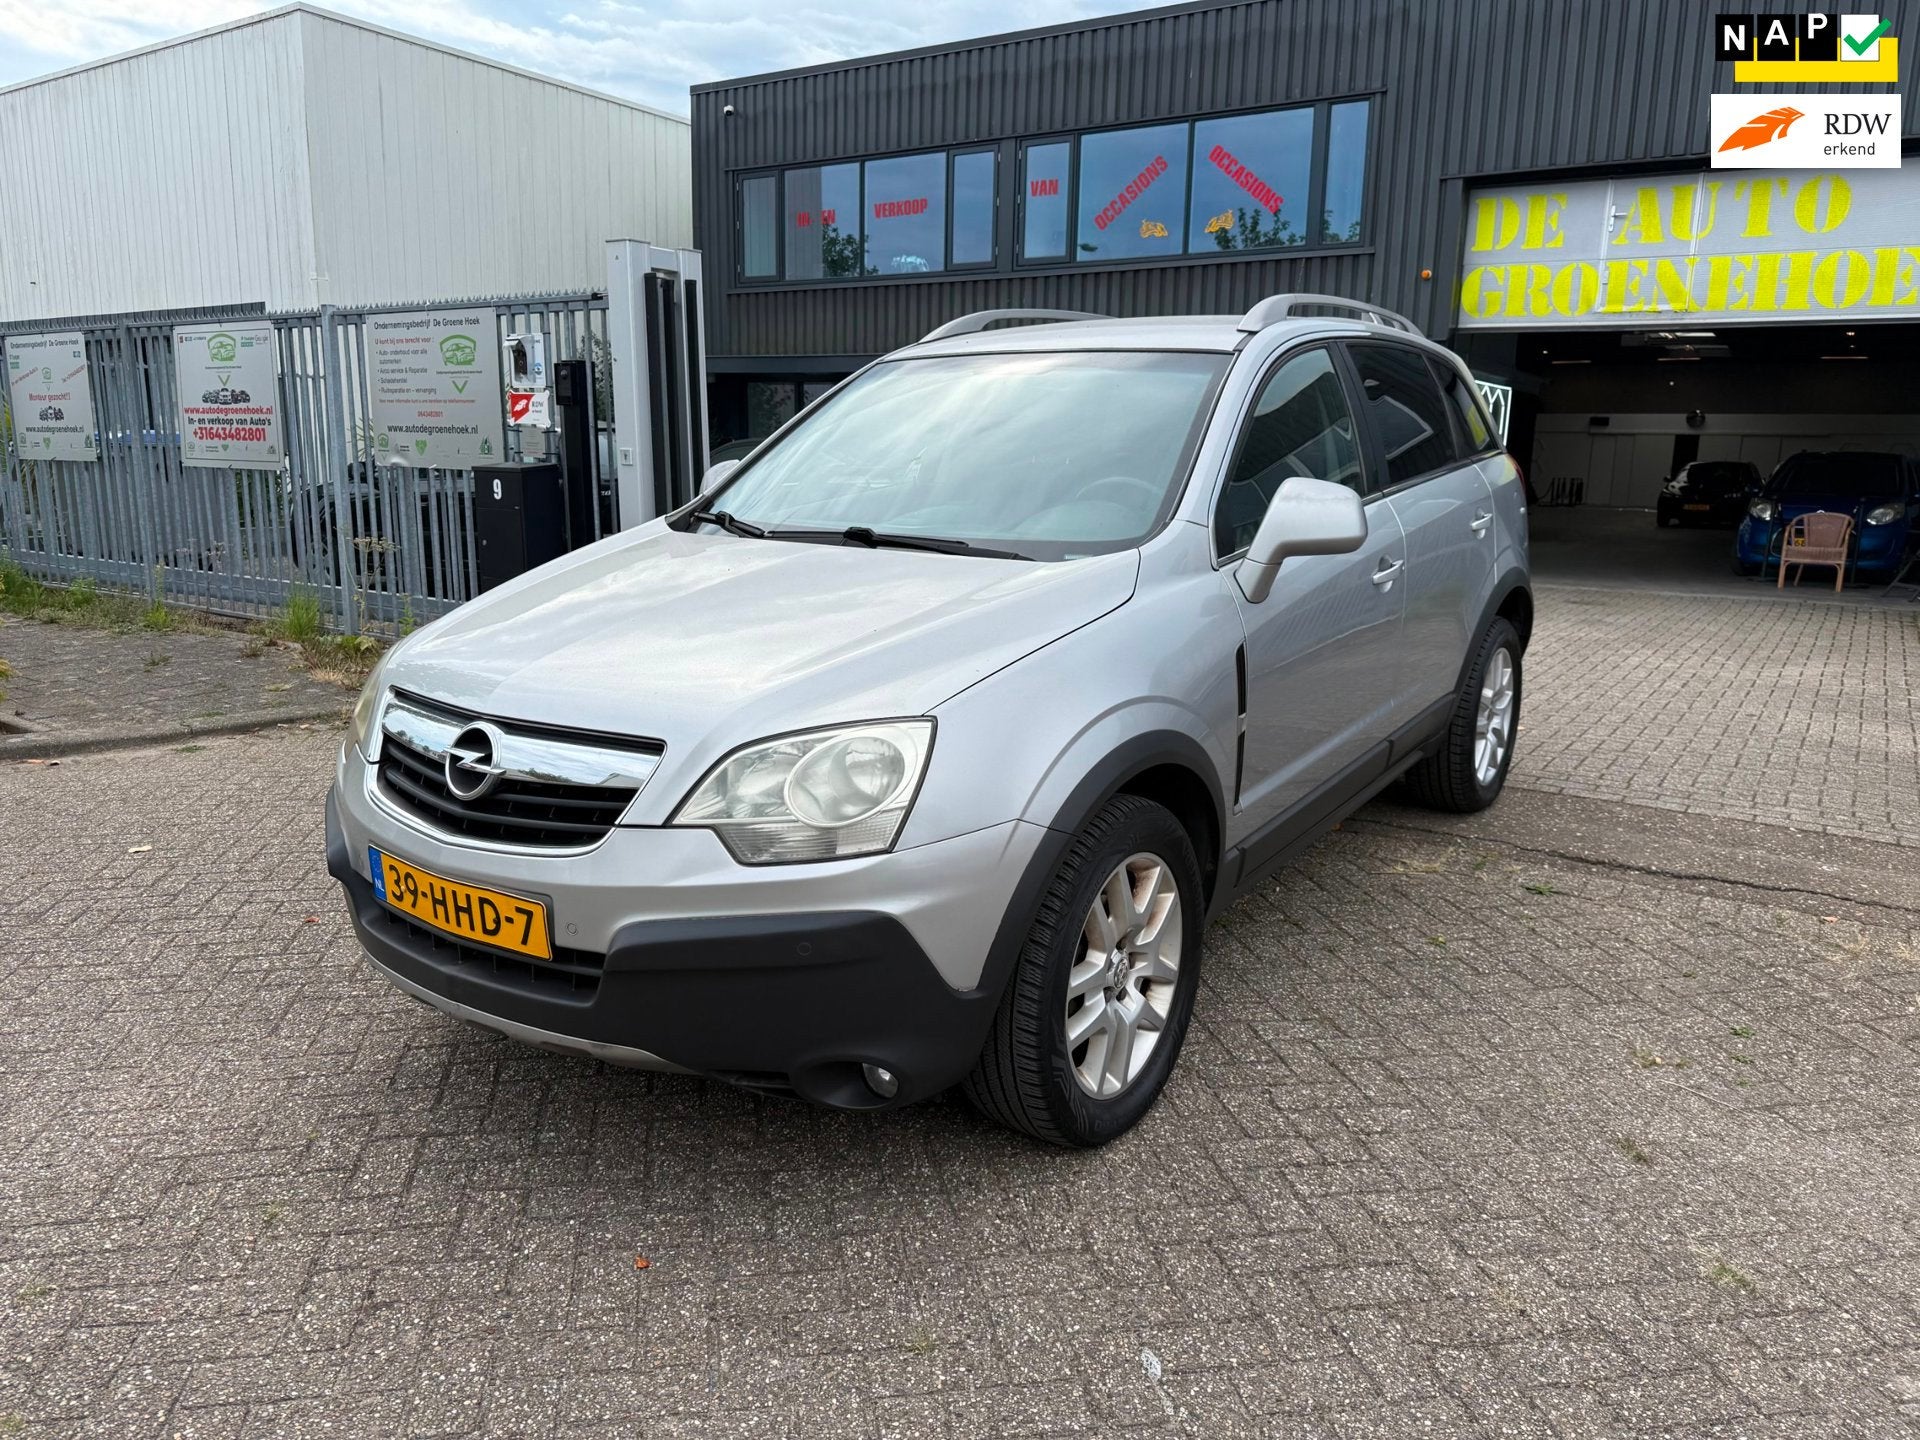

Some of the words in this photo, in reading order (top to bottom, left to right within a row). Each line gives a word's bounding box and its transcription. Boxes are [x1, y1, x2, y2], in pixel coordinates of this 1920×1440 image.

[1208, 144, 1284, 215] OCCASIONS
[821, 209, 836, 225] EN
[874, 198, 928, 219] VERKOOP
[1030, 179, 1059, 197] VAN
[1093, 154, 1169, 231] OCCASIONS
[1472, 193, 1567, 252] DE
[1611, 173, 1853, 246] AUTO
[433, 318, 441, 327] De
[442, 318, 463, 327] Groene
[464, 317, 480, 325] Hoek
[184, 405, 273, 416] www.autodegroenehoek.nl
[207, 417, 234, 427] verkoop
[249, 417, 271, 426] Auto's
[387, 424, 478, 436] www.autodegroenehoek.nl
[193, 426, 266, 442] +31643482801
[492, 478, 502, 500] 9
[375, 877, 385, 892] NL
[388, 864, 534, 946] 39-HHD-7
